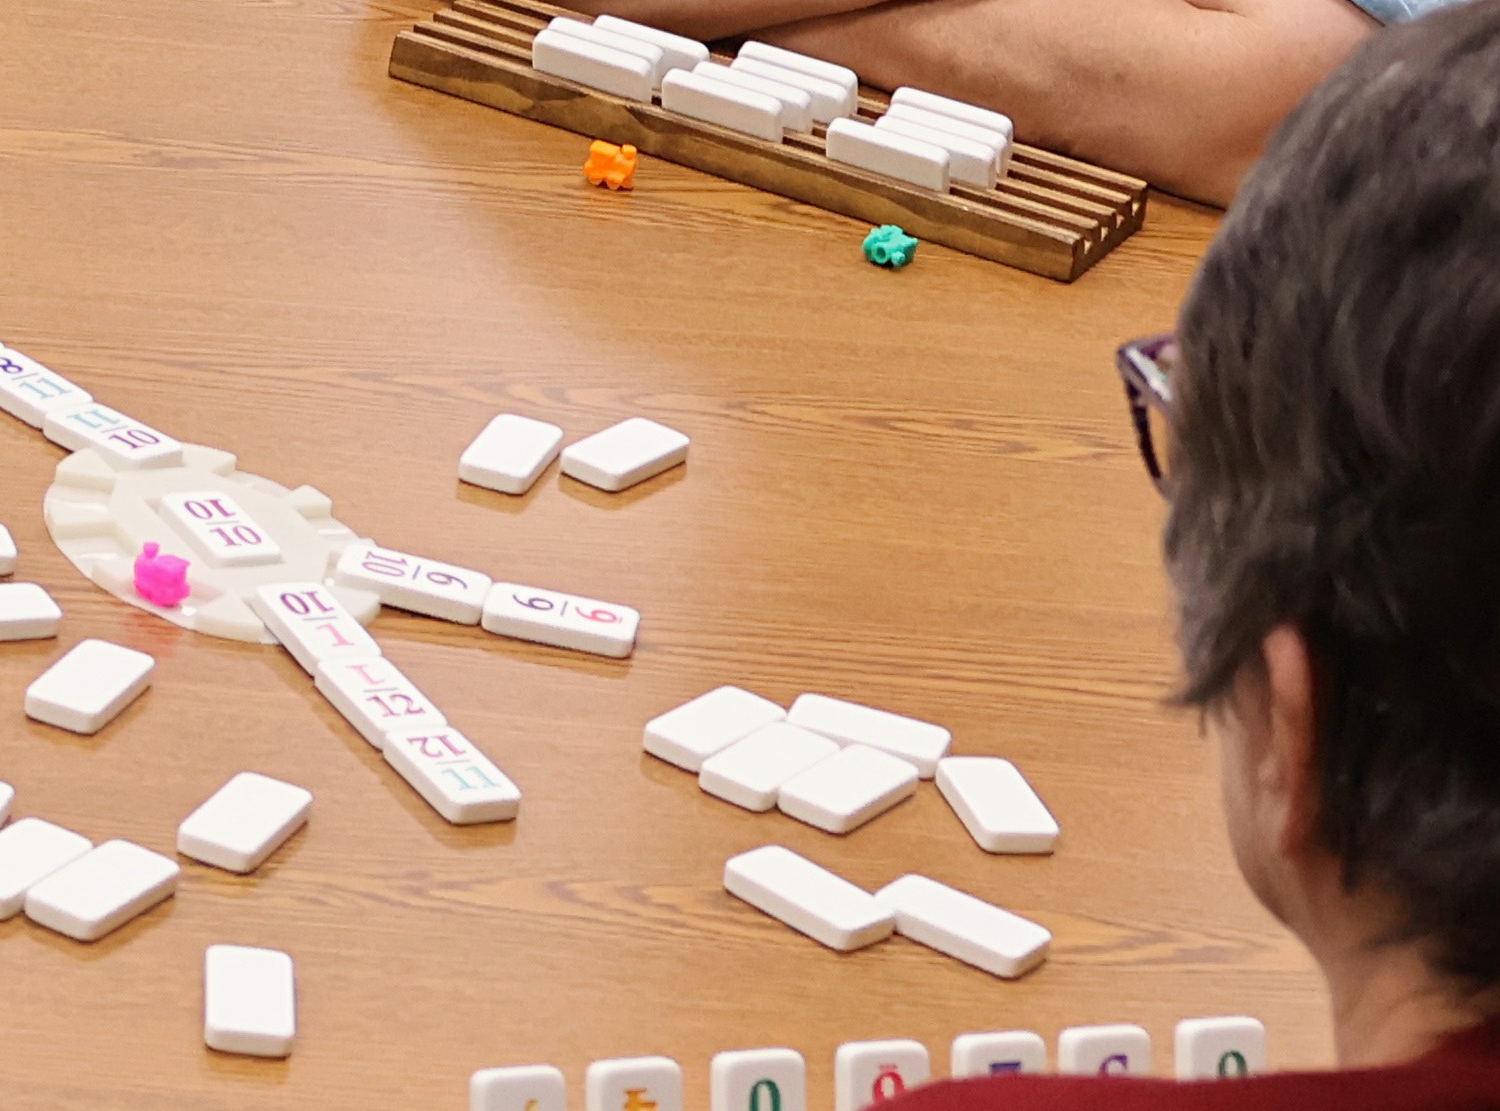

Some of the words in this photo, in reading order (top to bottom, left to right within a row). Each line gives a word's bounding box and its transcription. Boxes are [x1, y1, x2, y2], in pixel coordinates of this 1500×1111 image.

[18, 377, 73, 400] 11
[66, 409, 121, 429] 11
[109, 429, 160, 450] 10
[184, 499, 236, 520] 10
[210, 525, 262, 547] 10
[362, 551, 407, 577] 10
[280, 591, 334, 615] 10
[316, 623, 355, 647] 1
[346, 664, 385, 685] 1
[366, 694, 426, 717] 12
[407, 735, 466, 758] 12
[442, 766, 501, 791] 11
